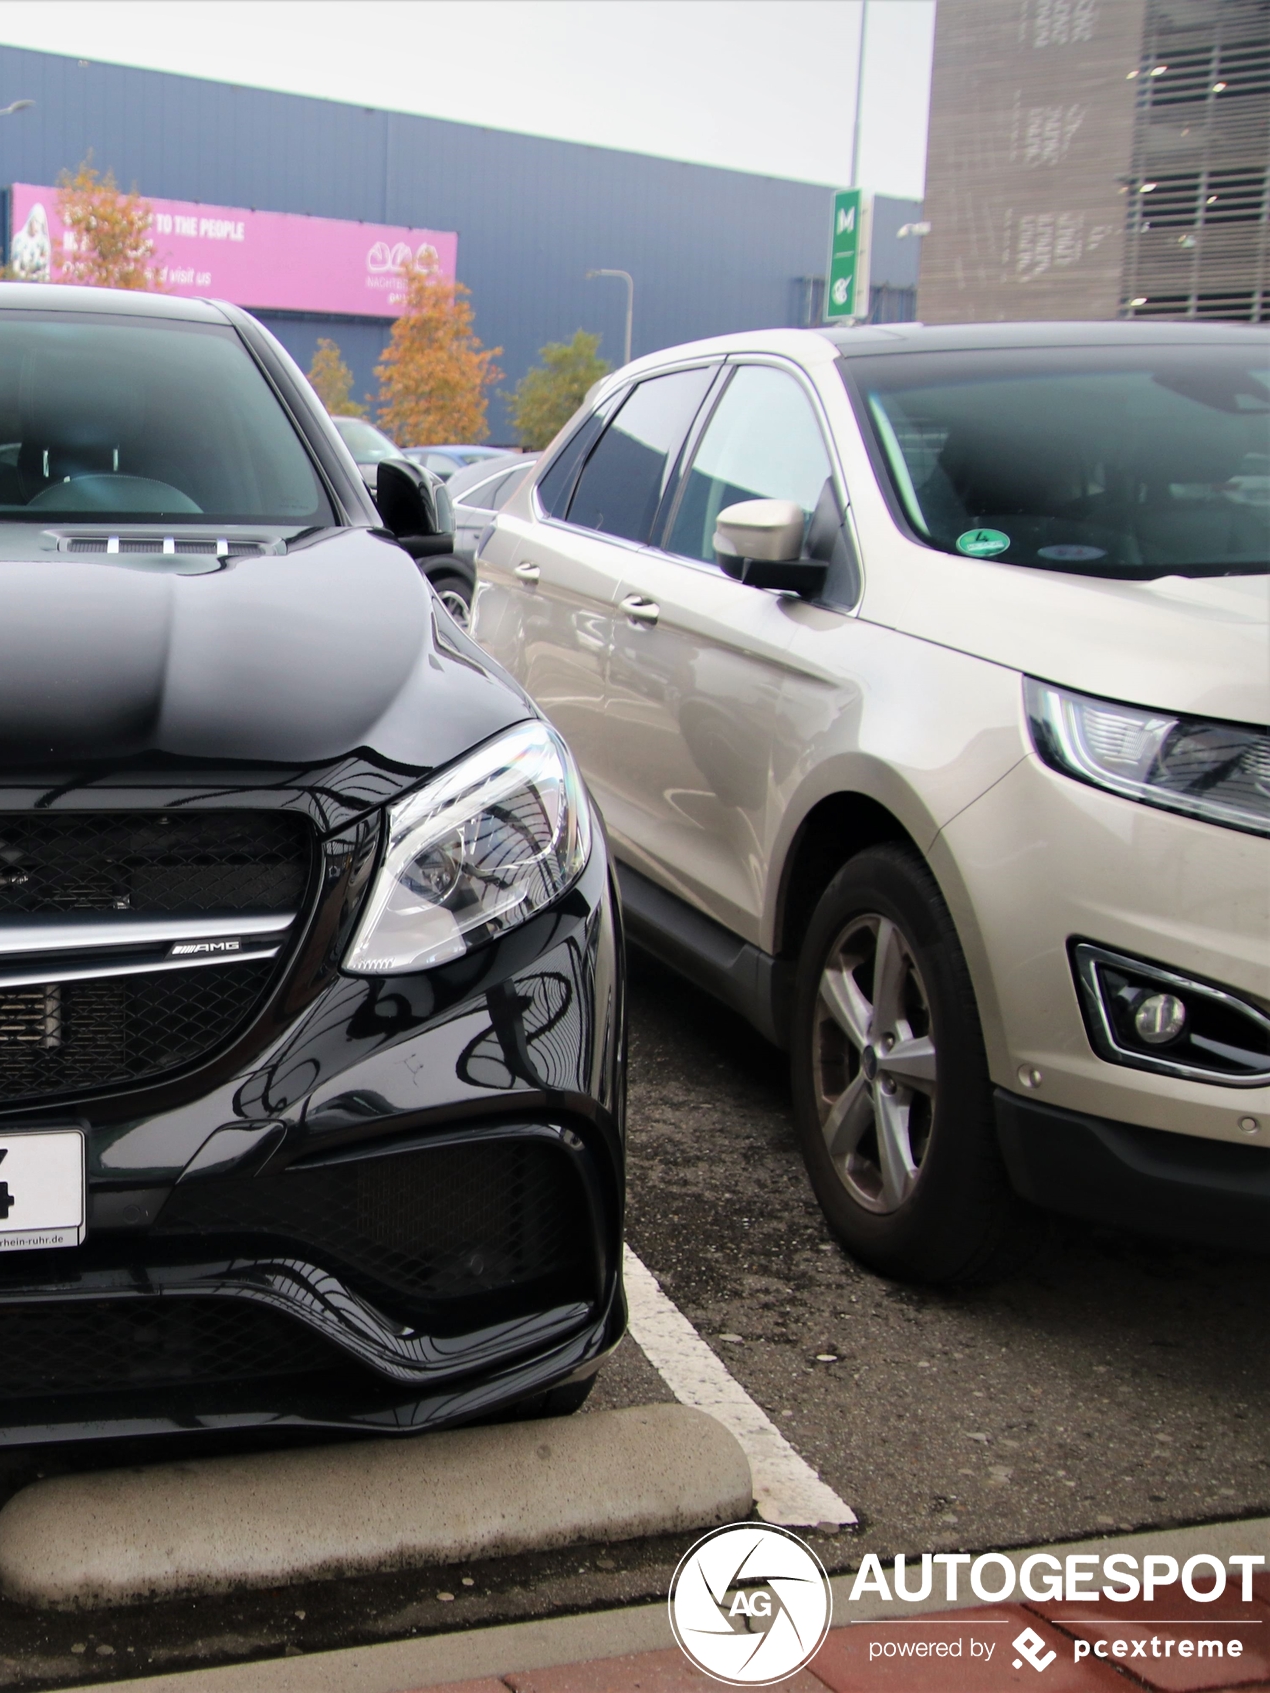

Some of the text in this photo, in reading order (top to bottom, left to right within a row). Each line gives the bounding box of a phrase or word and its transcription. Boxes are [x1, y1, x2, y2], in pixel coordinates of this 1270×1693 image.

[156, 213, 172, 233] TO
[174, 215, 198, 237] THE
[199, 218, 245, 242] PEOPLE
[170, 267, 194, 285] visit
[196, 272, 212, 285] us
[193, 941, 239, 953] AMG
